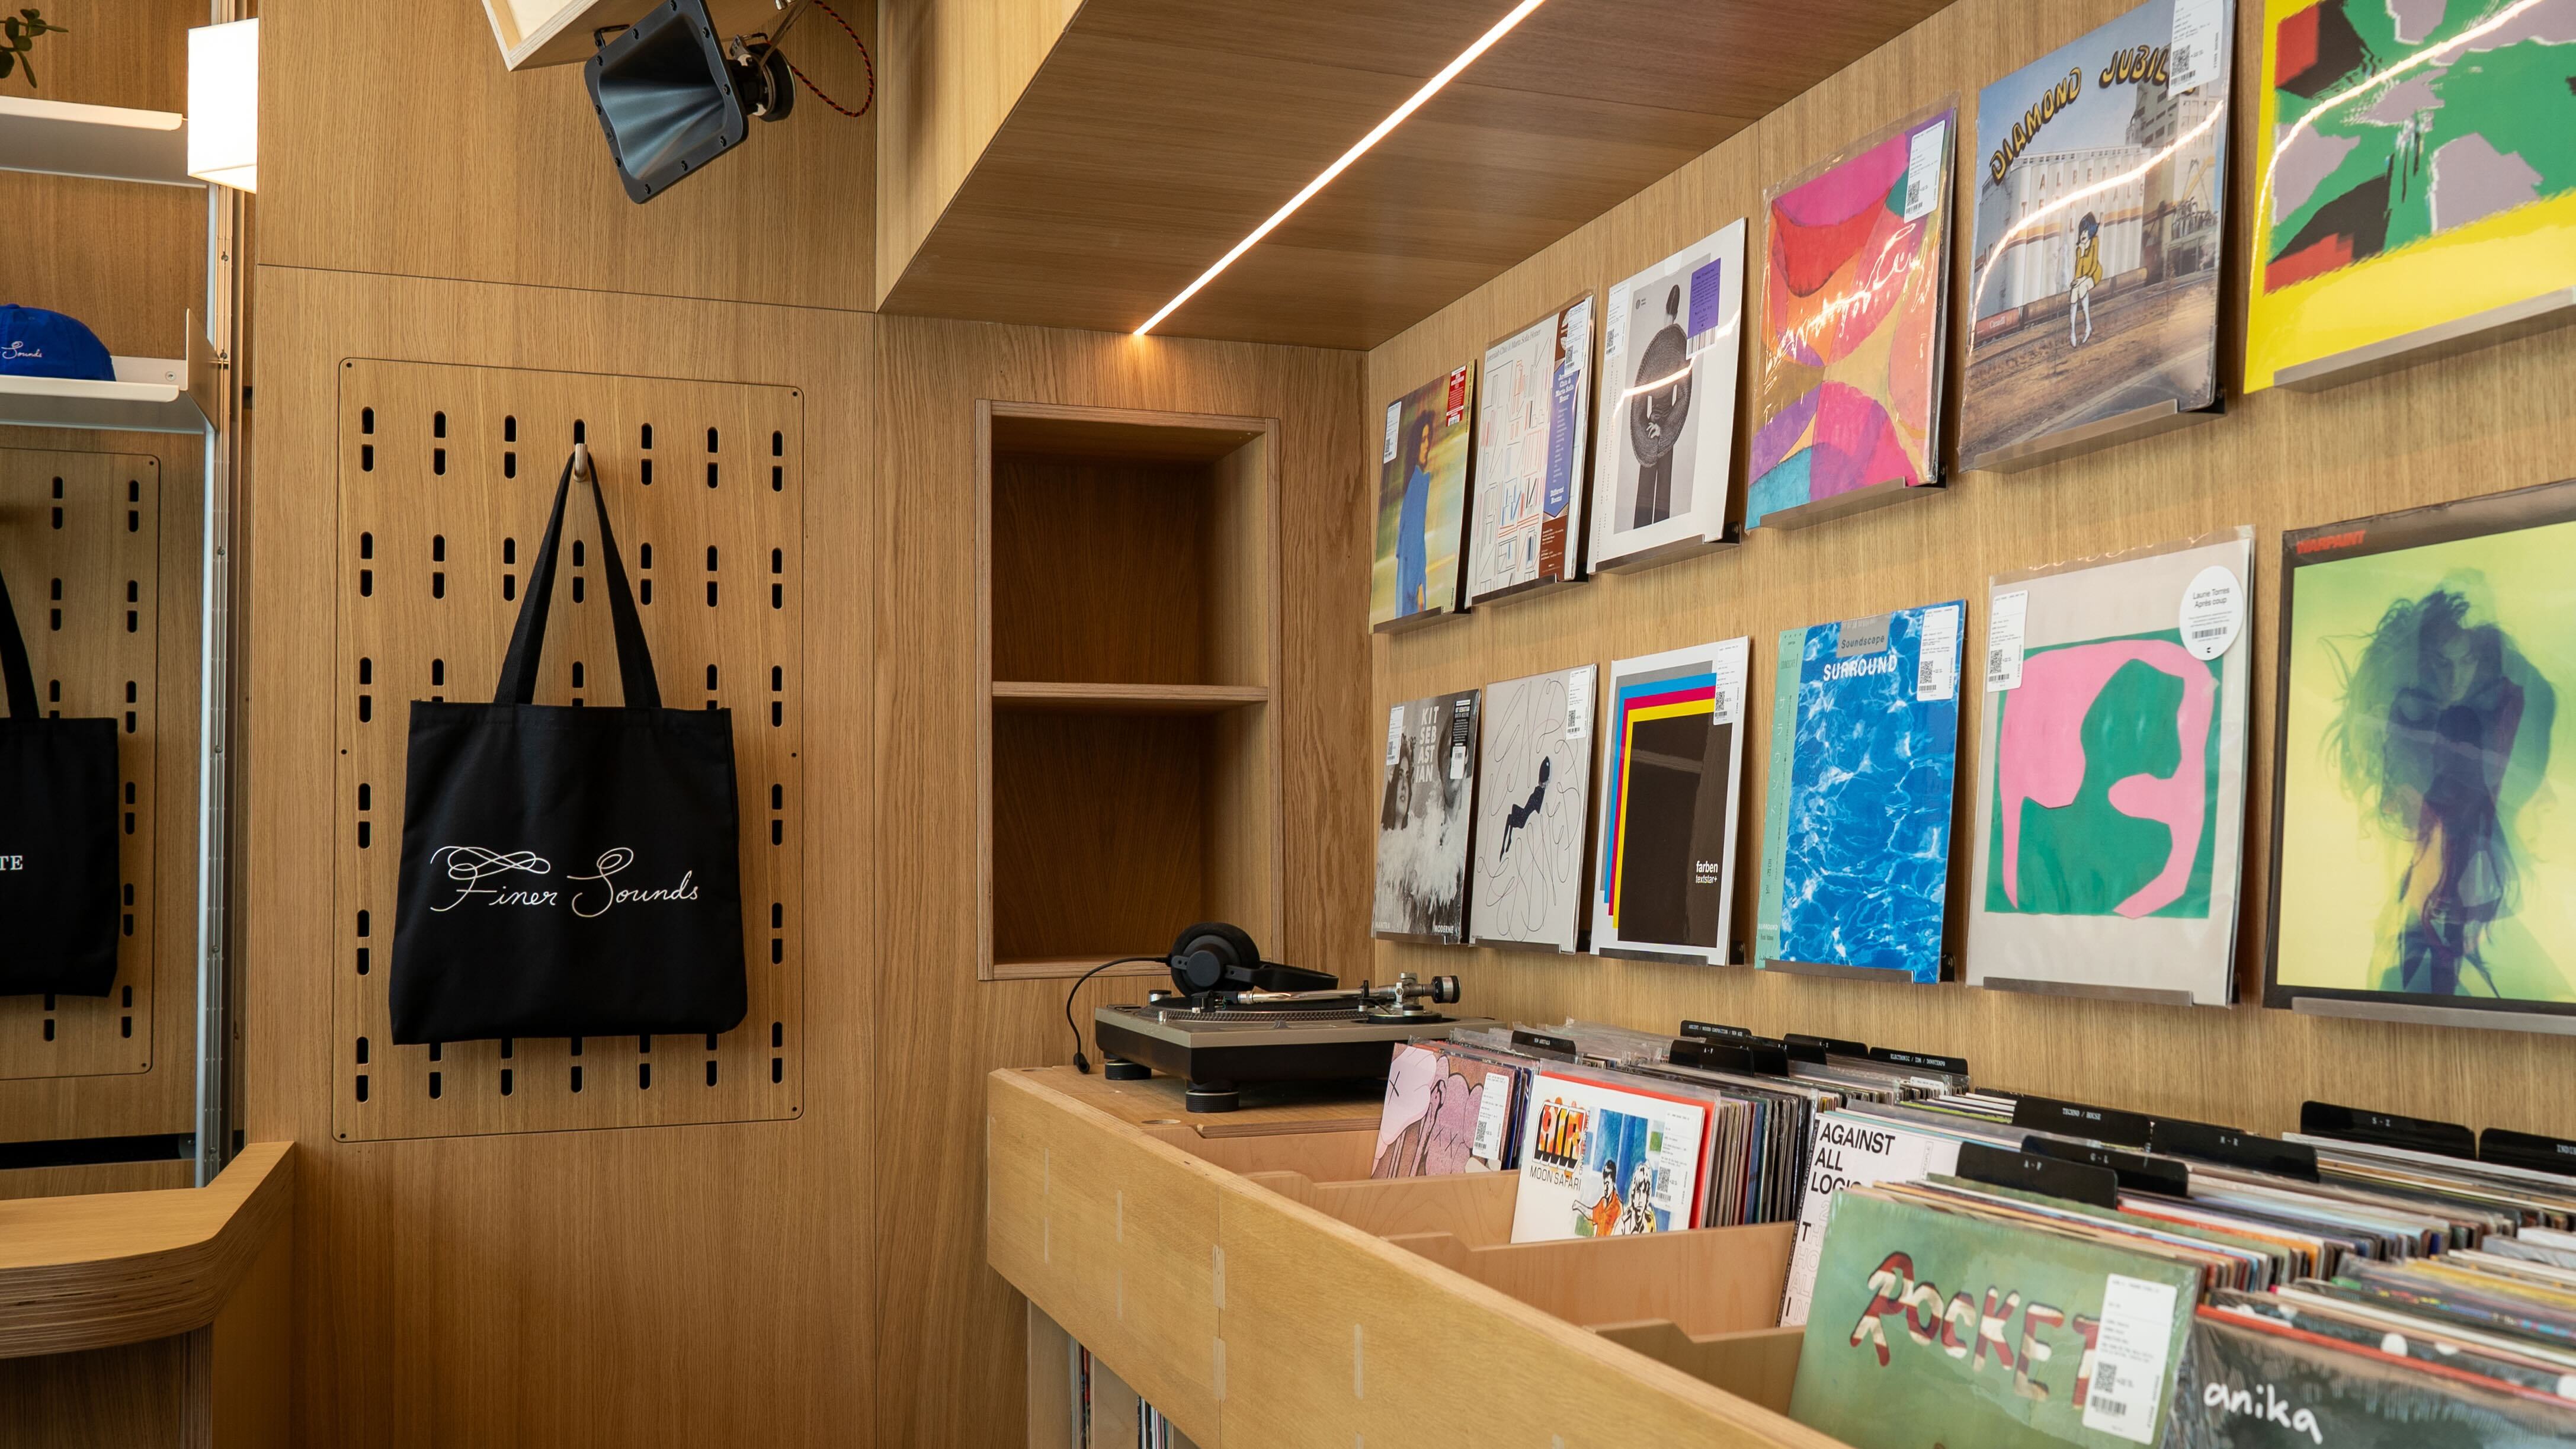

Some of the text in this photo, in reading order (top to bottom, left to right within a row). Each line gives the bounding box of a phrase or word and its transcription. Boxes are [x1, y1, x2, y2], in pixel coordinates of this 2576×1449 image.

[1989, 66, 2082, 185] DIAMOND
[2098, 44, 2171, 89] JUBIL
[1, 341, 42, 359] Sounds
[2296, 528, 2366, 555] WARPAINT
[1841, 635, 1885, 649] Soundscape
[1823, 654, 1898, 681] SURROUND
[1421, 706, 1440, 725] KIT
[1420, 725, 1437, 745] SEB
[1417, 745, 1435, 764] AST
[1415, 764, 1433, 783] IAN
[1696, 860, 1718, 873] farben
[430, 846, 699, 918] Finer Sounds
[1434, 924, 1454, 934] MODERNE
[1890, 1053, 1910, 1062] ELECTRONIC
[2062, 1107, 2080, 1117] TECHNO
[2086, 1111, 2101, 1120] HOUSE
[1533, 1100, 1586, 1172] AIR
[1819, 1123, 1895, 1155] AGAINST
[1815, 1147, 1843, 1172] ALL
[2024, 1159, 2029, 1168] A
[1530, 1165, 1582, 1191] MOON SAFARI
[1850, 1251, 2101, 1410] POCKET
[2203, 1382, 2323, 1445] anika
